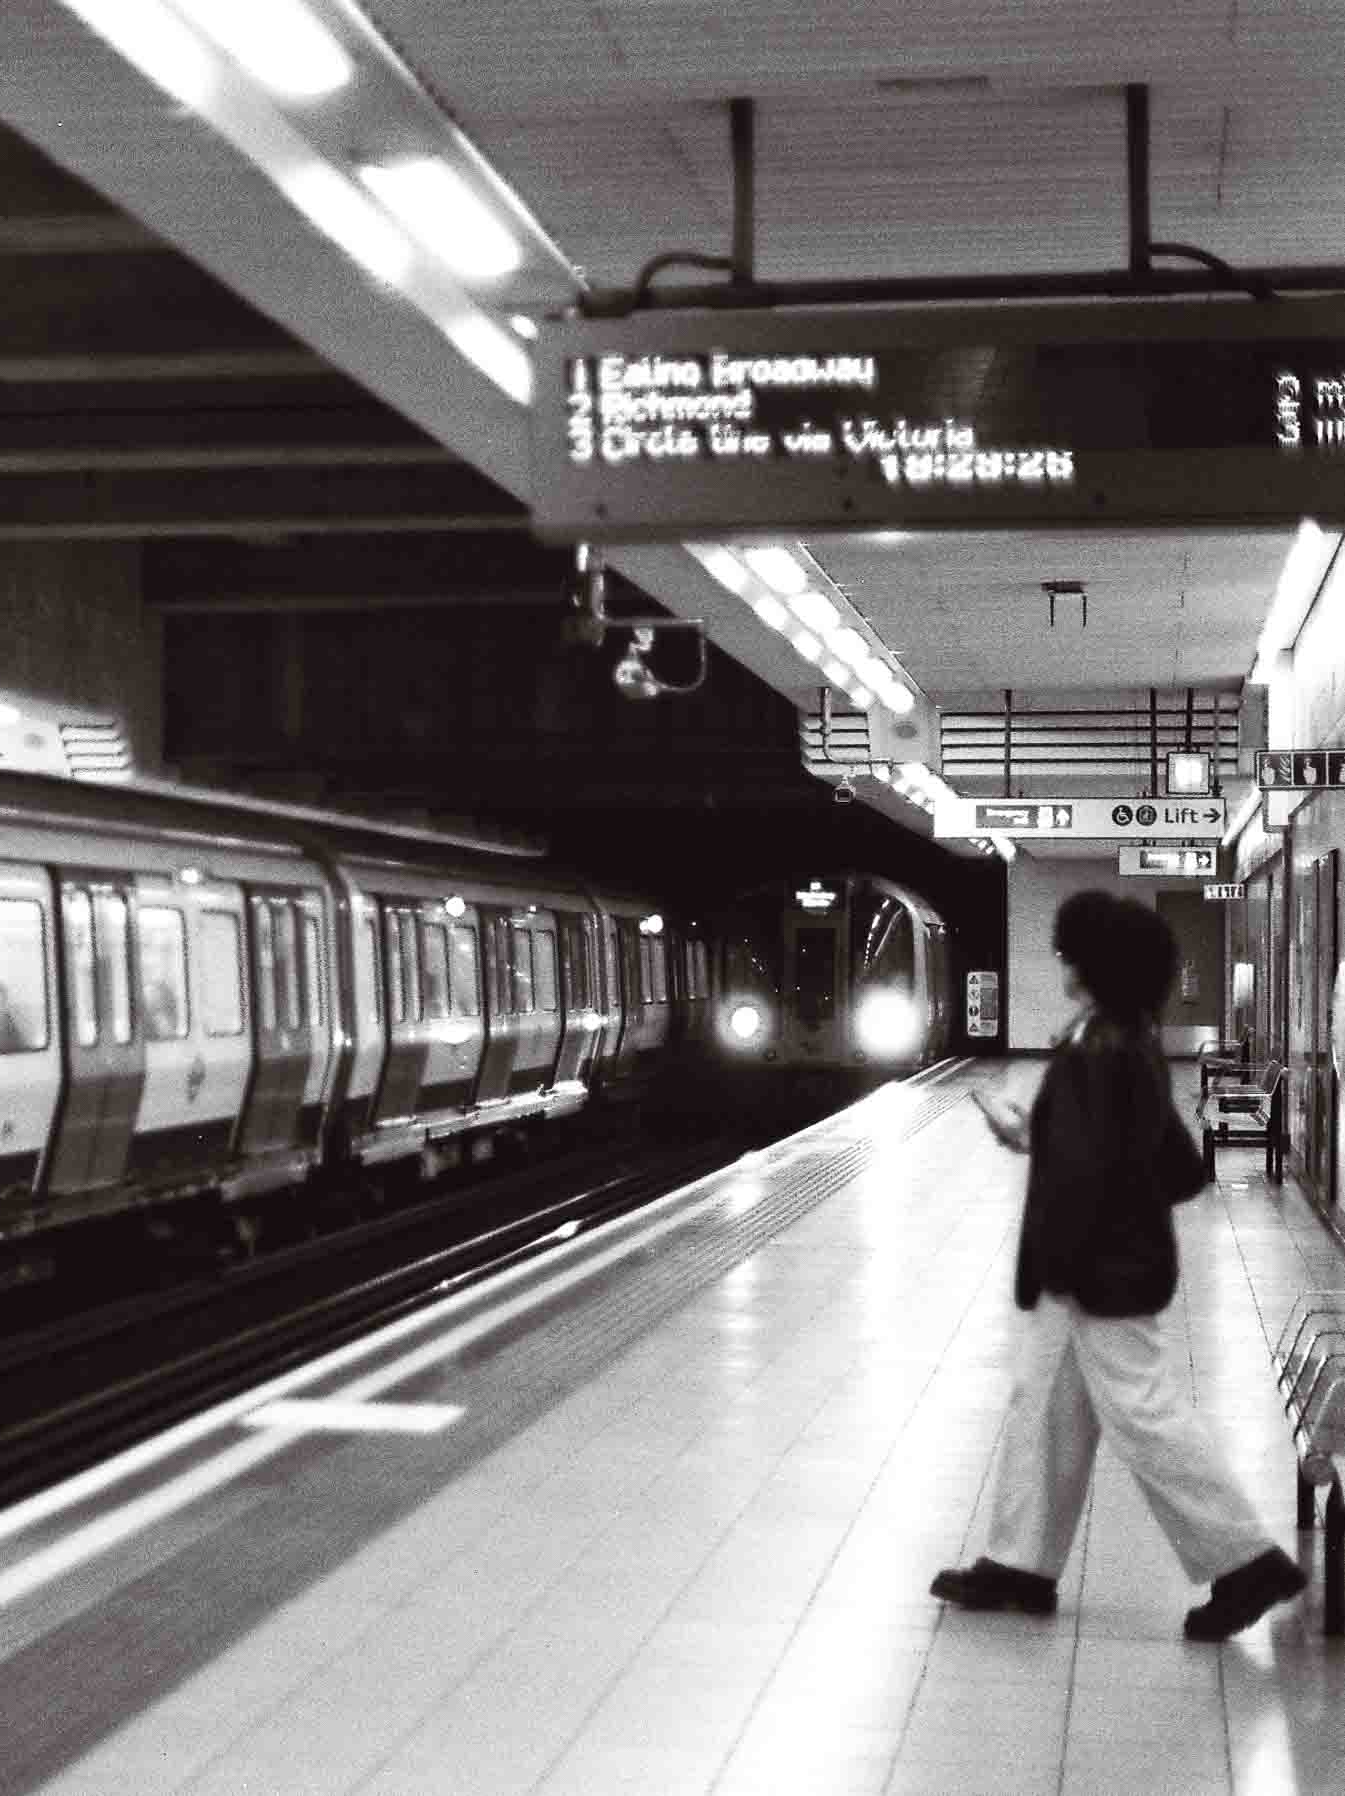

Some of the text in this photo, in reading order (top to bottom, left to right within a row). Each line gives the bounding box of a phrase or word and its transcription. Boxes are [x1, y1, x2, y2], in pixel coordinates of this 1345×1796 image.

[573, 357, 586, 391] 1
[601, 424, 698, 460] Circle
[783, 421, 831, 452] via
[841, 418, 974, 454] Victoria
[1164, 807, 1199, 824] Lift
